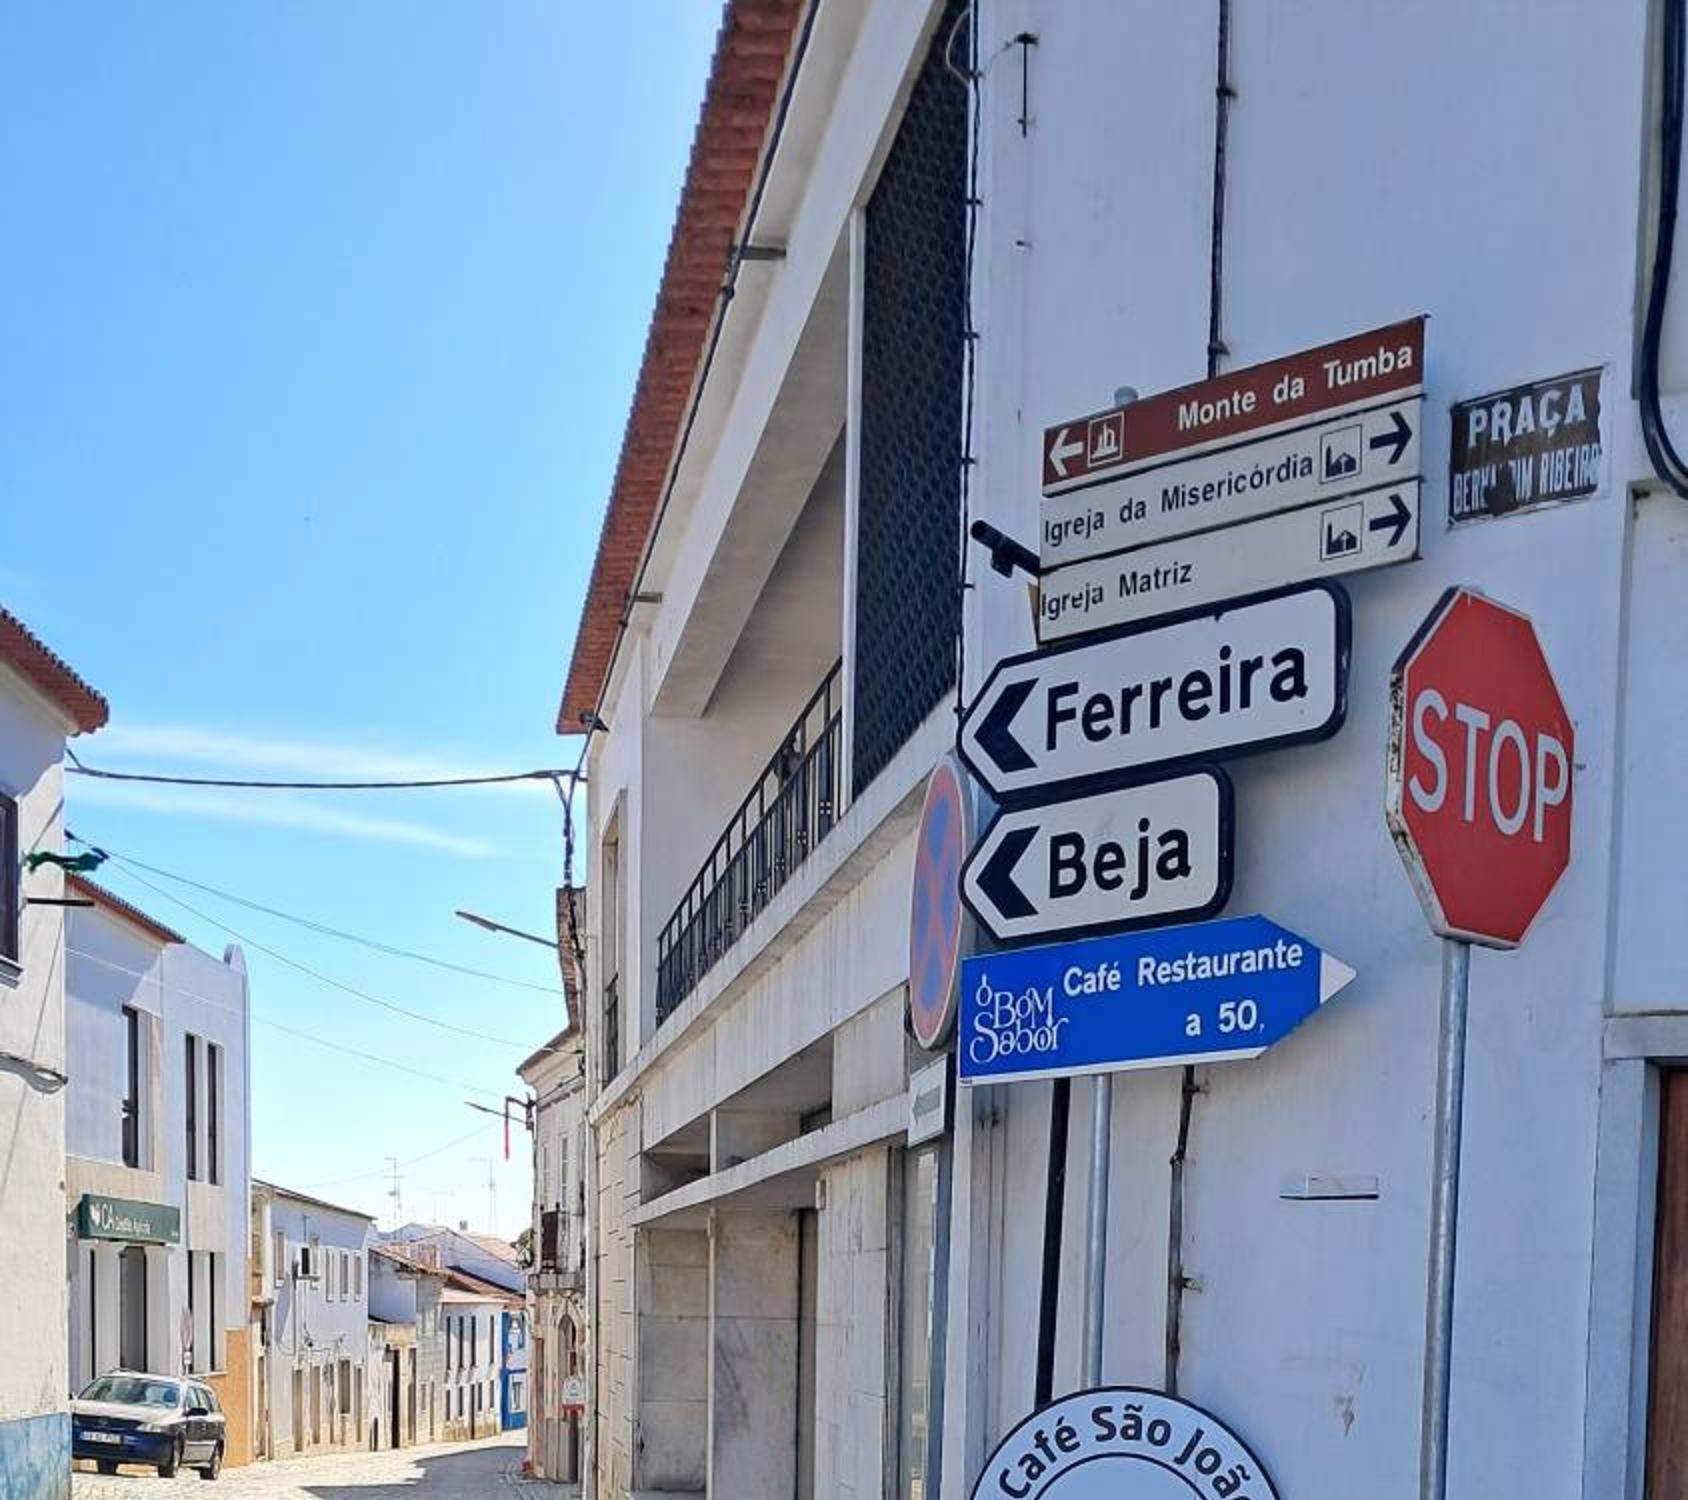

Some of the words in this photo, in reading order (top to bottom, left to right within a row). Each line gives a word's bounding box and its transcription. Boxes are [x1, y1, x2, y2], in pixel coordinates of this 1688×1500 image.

[1178, 391, 1257, 432] Monte
[1274, 374, 1305, 404] da
[1323, 345, 1413, 390] Tumba
[1468, 384, 1586, 448] PRAÇA
[1044, 508, 1105, 548] Igreja
[1119, 497, 1147, 524] da
[1159, 452, 1313, 514] Misericórdia
[1041, 583, 1104, 621] Igreja
[1119, 561, 1193, 598] Matriz
[1045, 645, 1309, 752] Ferreira
[1408, 688, 1569, 843] STOP
[1048, 817, 1192, 901] Beja
[1063, 961, 1121, 997] Café
[1137, 938, 1303, 987] Restaurante
[969, 1011, 1070, 1064] Sabor
[1185, 1013, 1202, 1037] a
[998, 1416, 1081, 1500] Café
[1091, 1404, 1172, 1447] São
